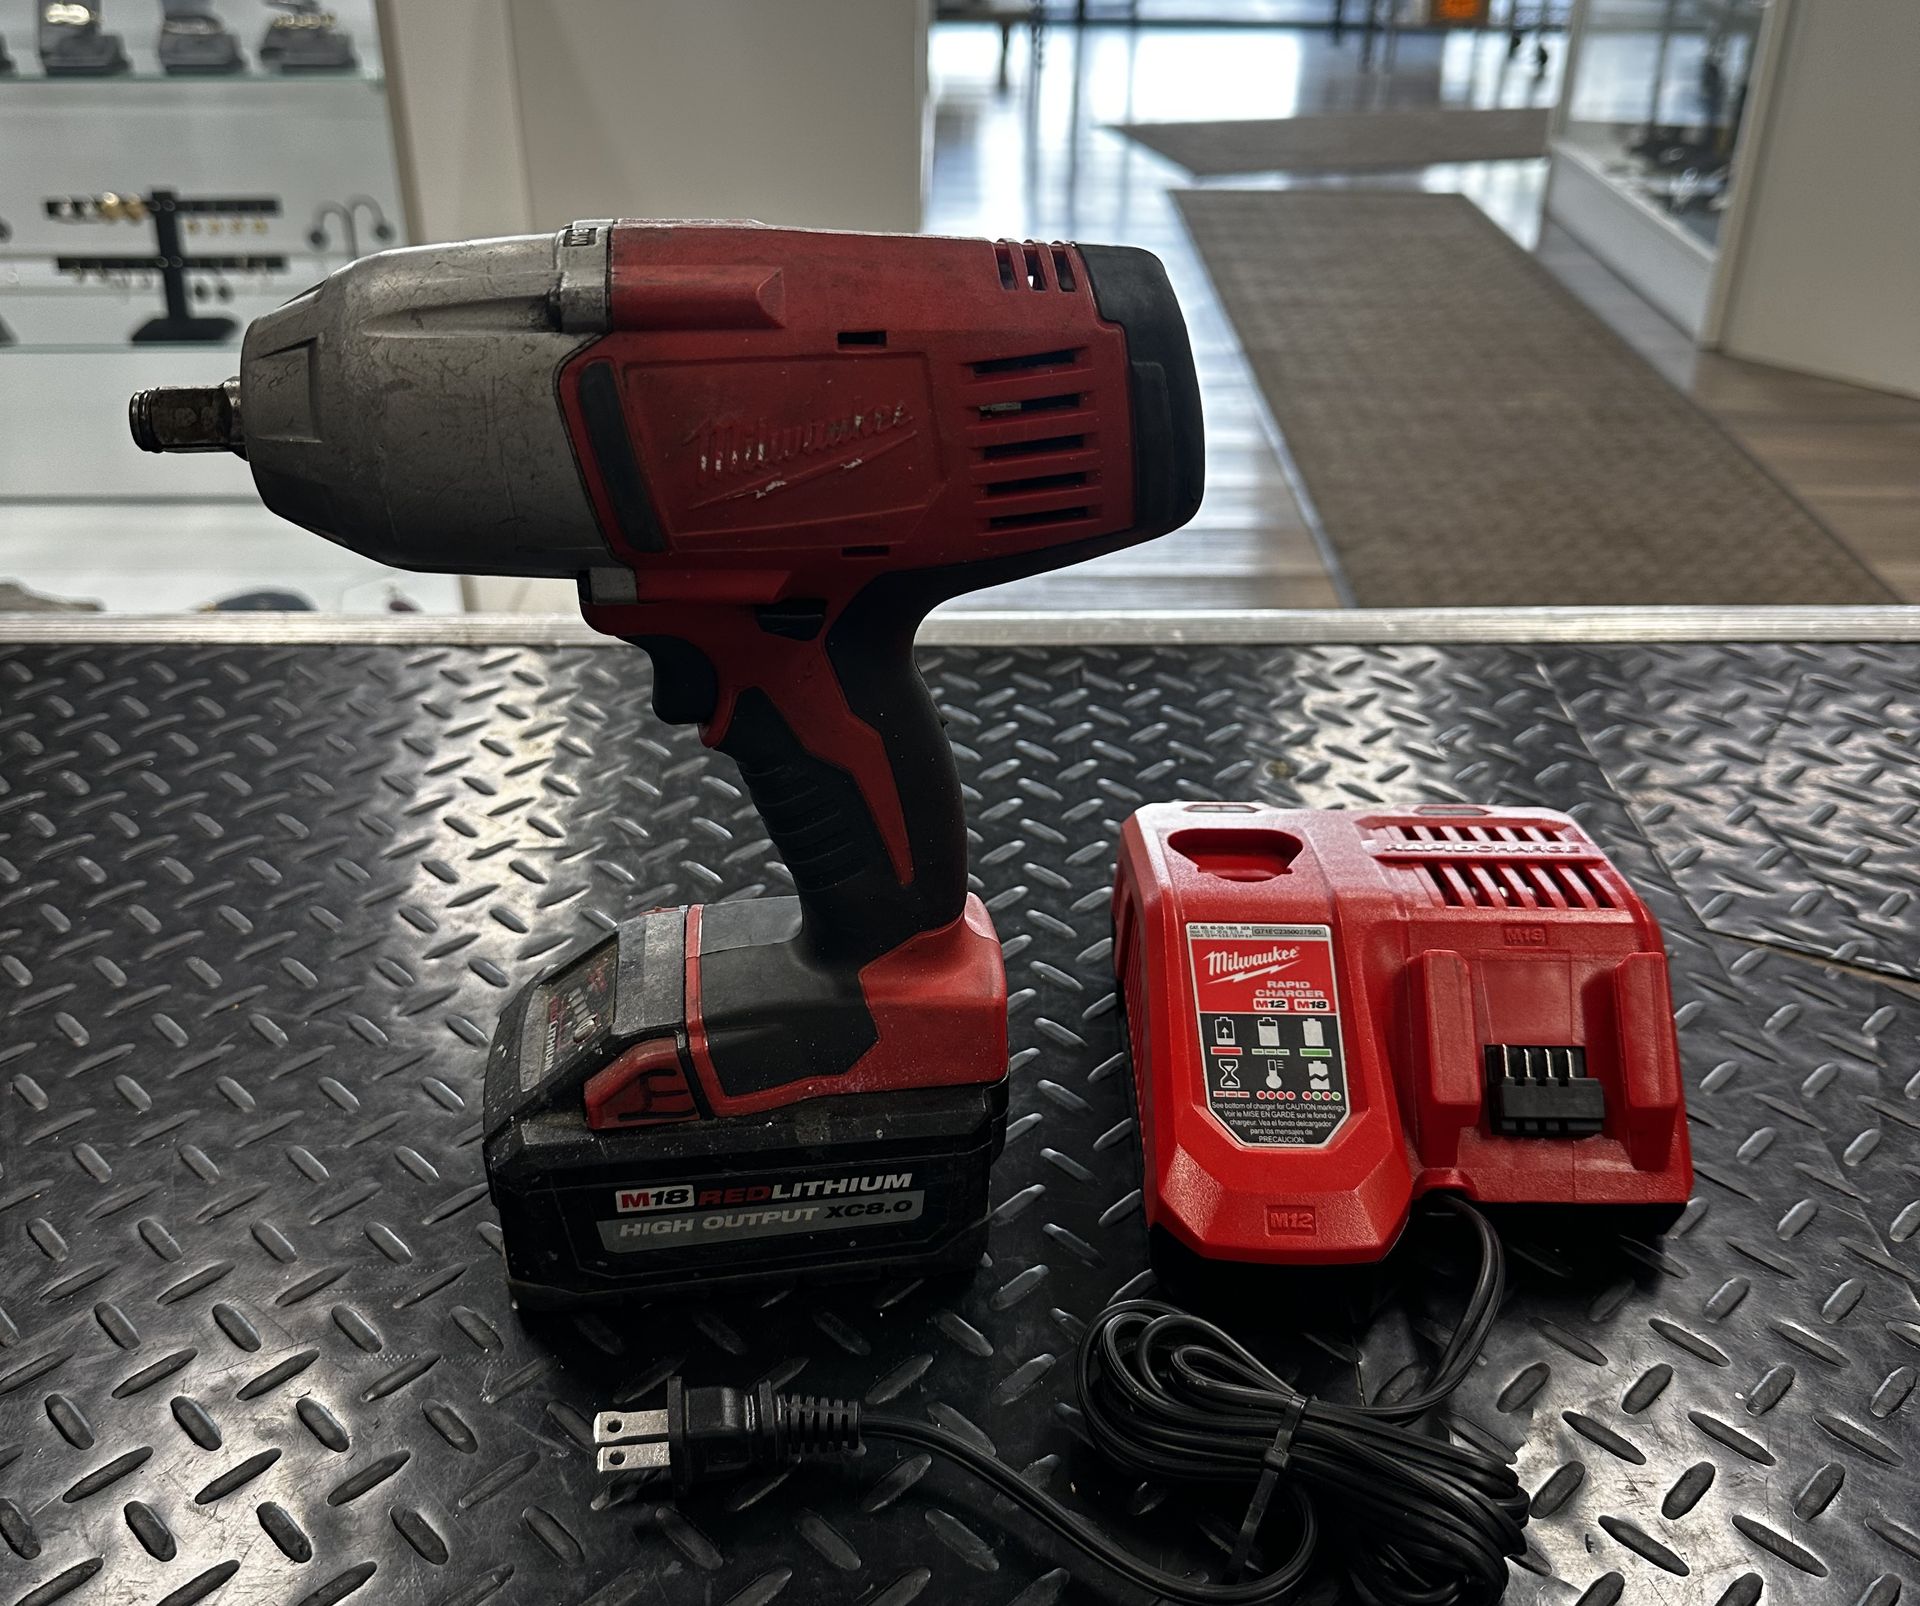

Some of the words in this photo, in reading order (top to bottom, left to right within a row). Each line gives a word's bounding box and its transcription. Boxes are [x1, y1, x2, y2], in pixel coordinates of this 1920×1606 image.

[1201, 946, 1299, 977] Milwaukee
[1266, 980, 1311, 989] RAPID
[1254, 989, 1326, 998] CHARGER
[1255, 1000, 1287, 1009] M12
[1296, 1001, 1328, 1010] M18
[1211, 1101, 1224, 1109] See
[1253, 1102, 1276, 1111] charger
[1277, 1102, 1286, 1110] for
[1286, 1103, 1316, 1111] CAUTION
[1223, 1110, 1237, 1118] Voir
[1236, 1110, 1243, 1118] le
[1243, 1110, 1260, 1118] MISE
[1271, 1111, 1296, 1119] GARDE
[1271, 1119, 1278, 1127] el
[1278, 1119, 1295, 1127] fondo
[1275, 1128, 1304, 1137] mensajes
[1304, 1128, 1313, 1136] de
[621, 1189, 690, 1209] M18
[697, 1173, 913, 1206] REDLITHIUM
[619, 1218, 695, 1237] HIGH
[701, 1207, 820, 1231] OUTPUT
[825, 1200, 913, 1219] XC8.0
[1271, 1212, 1314, 1229] M12
